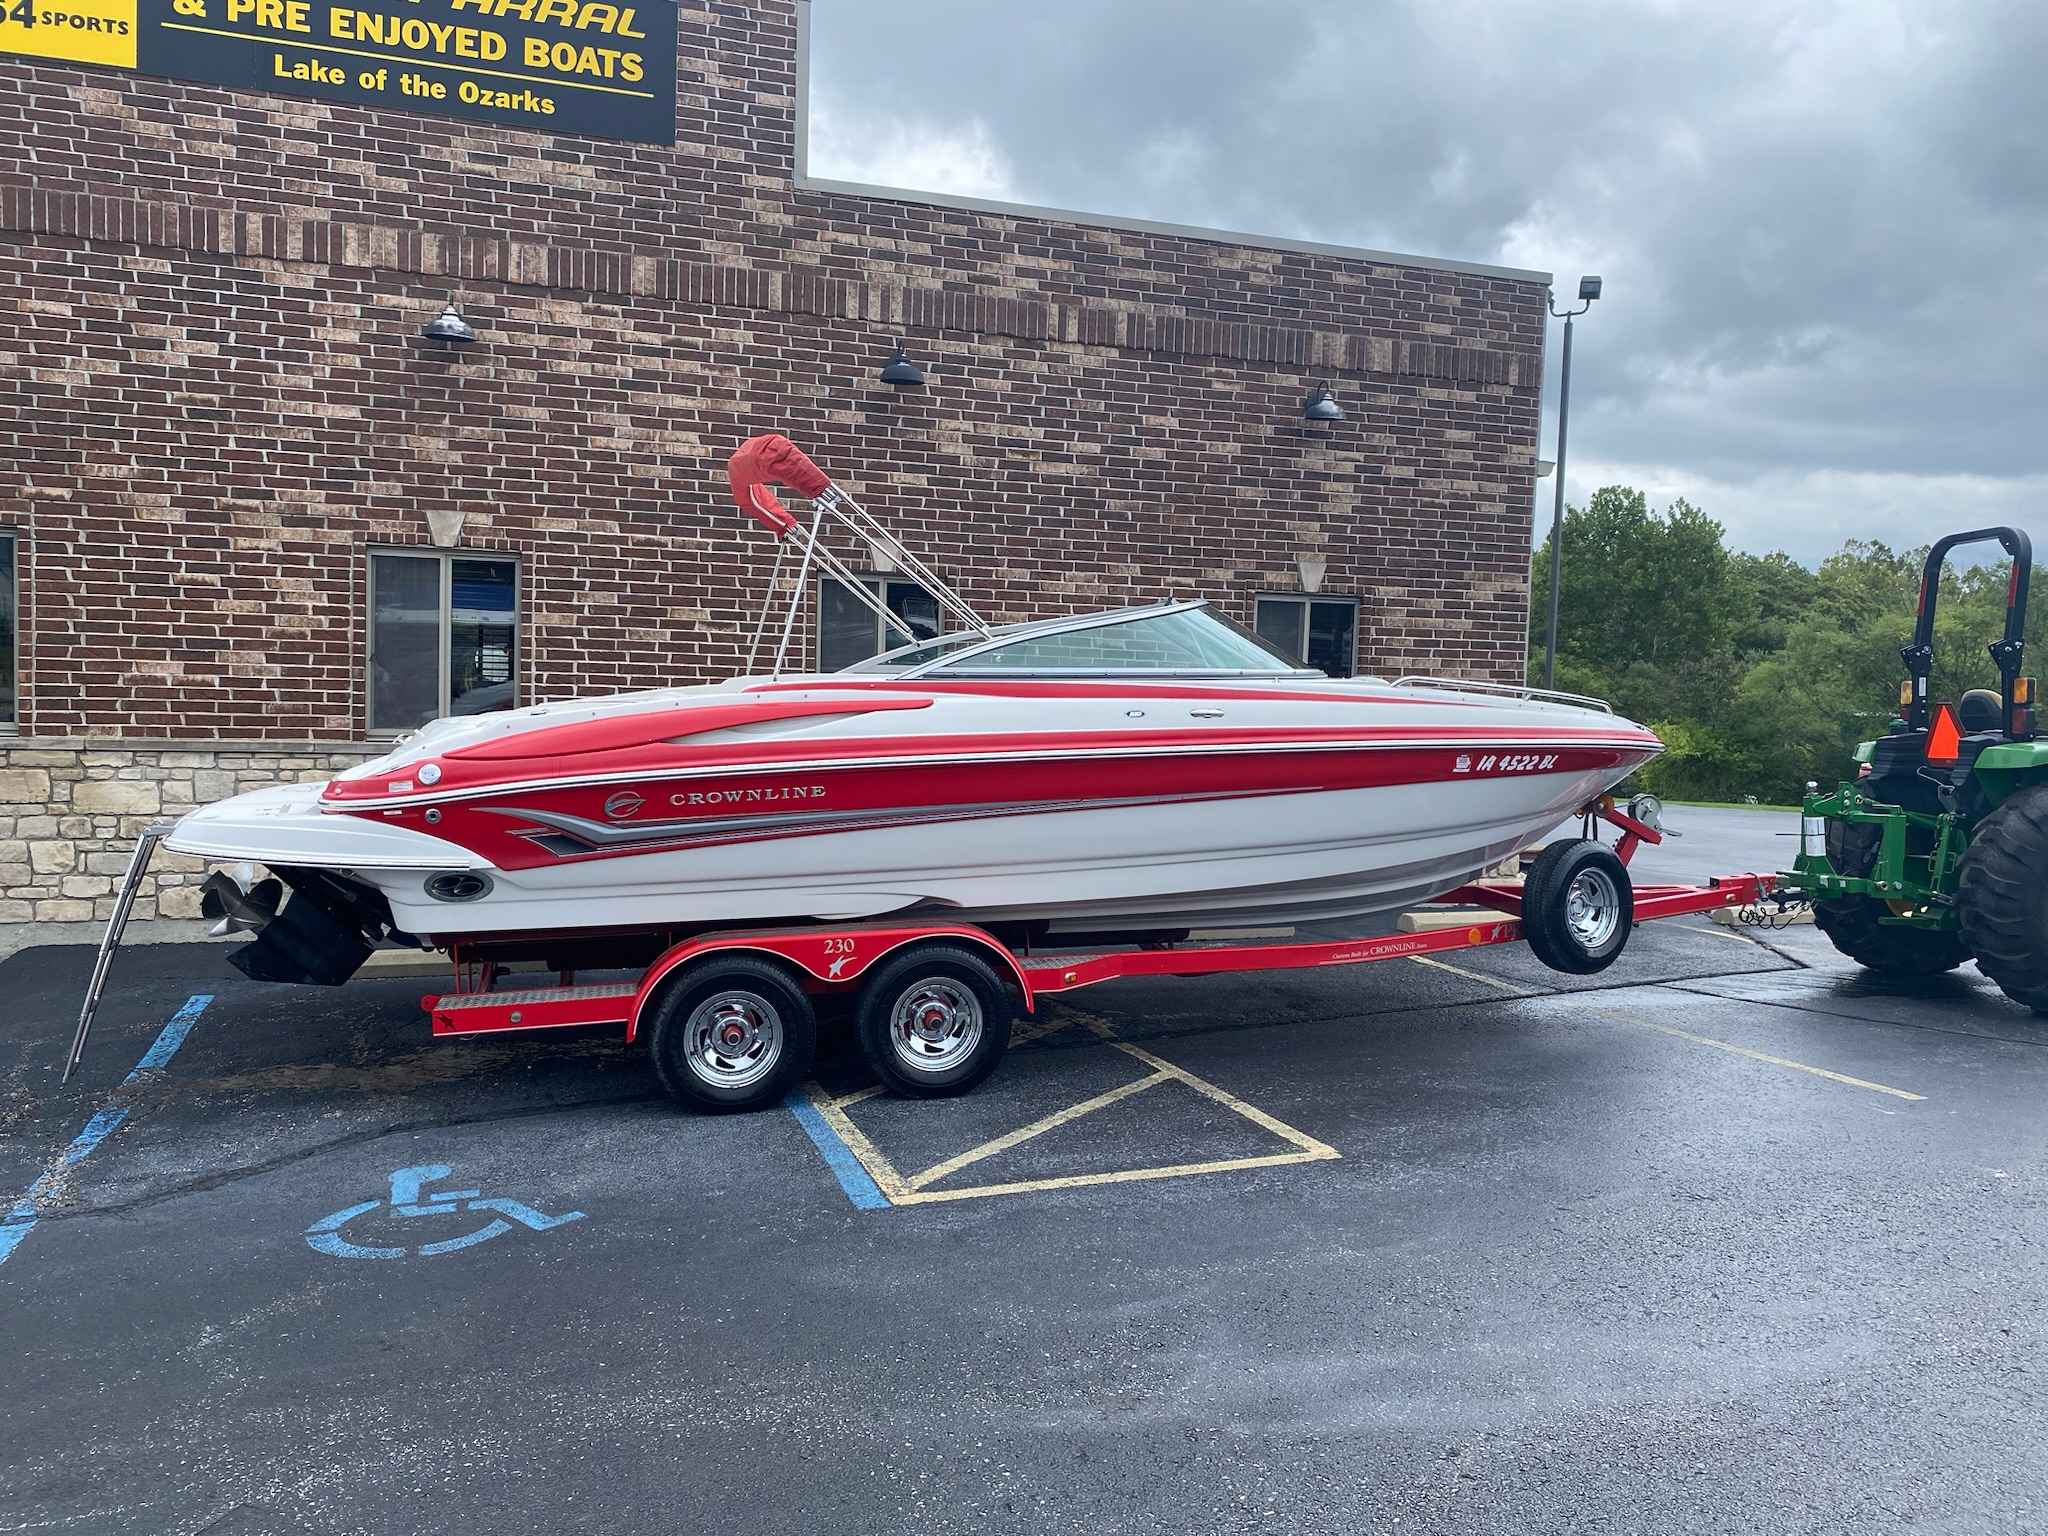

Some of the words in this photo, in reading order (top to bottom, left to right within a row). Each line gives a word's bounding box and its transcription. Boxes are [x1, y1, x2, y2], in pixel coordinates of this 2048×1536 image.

[42, 11, 128, 35] SPORTS
[173, 0, 207, 17] &
[227, 0, 311, 33] PRE
[330, 7, 507, 61] ENJOYED
[524, 37, 645, 82] BOATS
[274, 54, 346, 85] Lake
[358, 69, 387, 91] of
[400, 73, 447, 99] the
[458, 81, 556, 114] Ozarks
[1476, 755, 1497, 771] IA
[1499, 755, 1540, 771] 4522
[670, 785, 827, 806] CROWNLINE
[823, 938, 855, 954] 230
[1370, 942, 1417, 955] CROWNLINE
